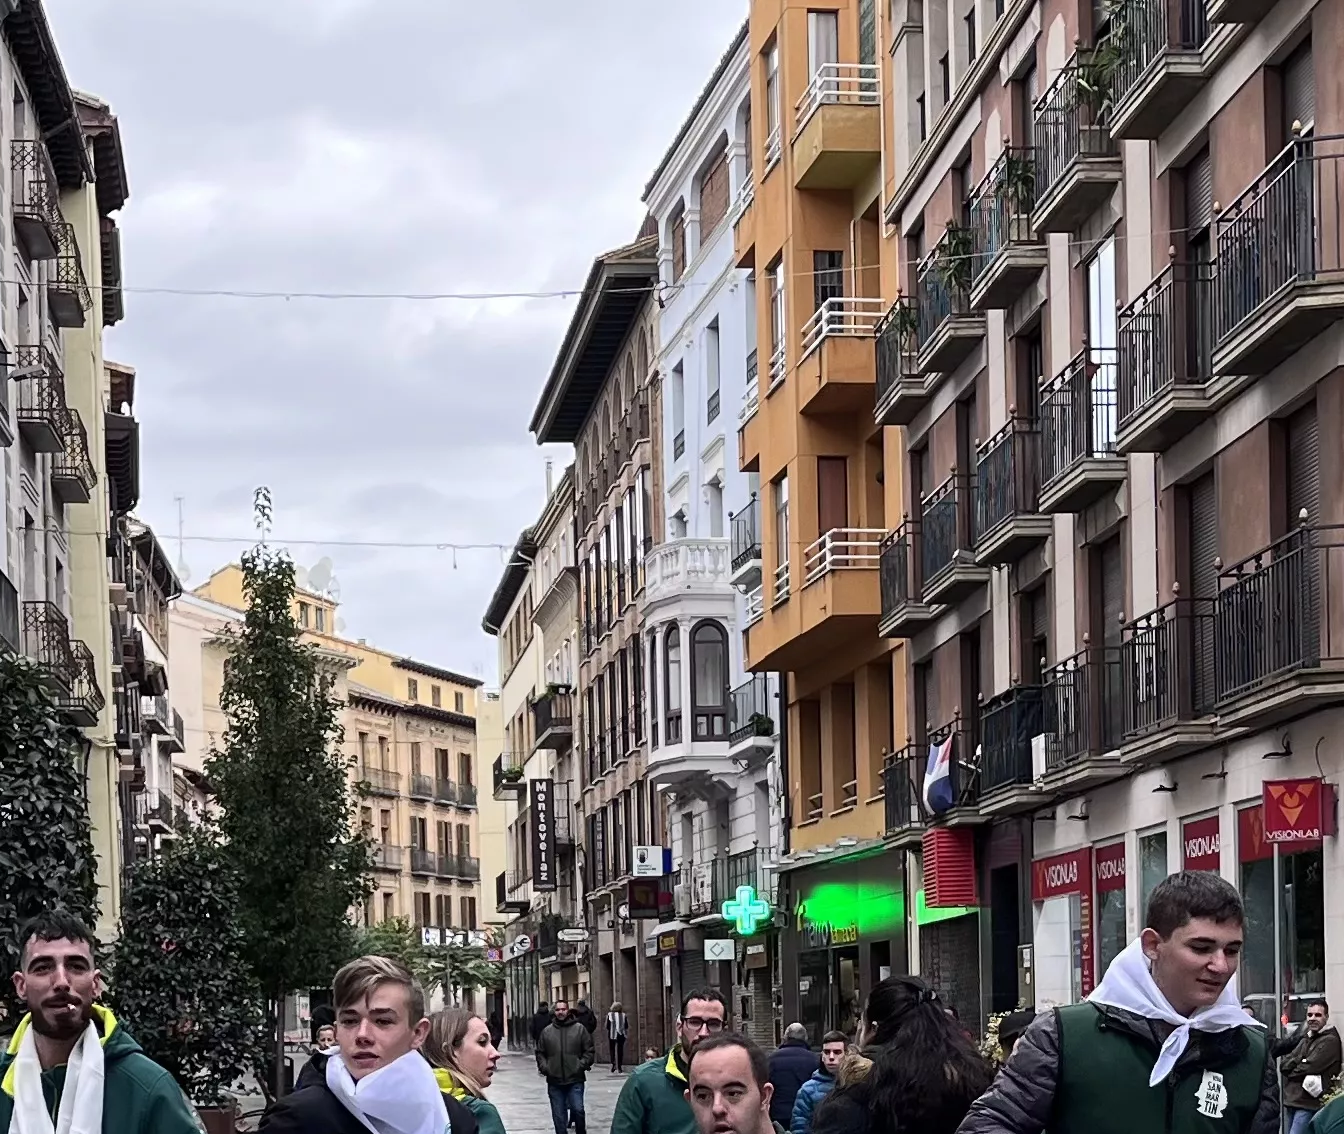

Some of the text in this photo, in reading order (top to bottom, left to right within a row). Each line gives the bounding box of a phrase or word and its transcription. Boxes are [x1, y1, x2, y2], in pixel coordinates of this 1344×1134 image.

[1266, 829, 1320, 840] VISIONLAB
[1185, 833, 1220, 858] VISIONLAB
[1044, 860, 1078, 888] VISIONLAB
[1207, 1080, 1222, 1094] SAN
[1204, 1100, 1218, 1115] TIN
